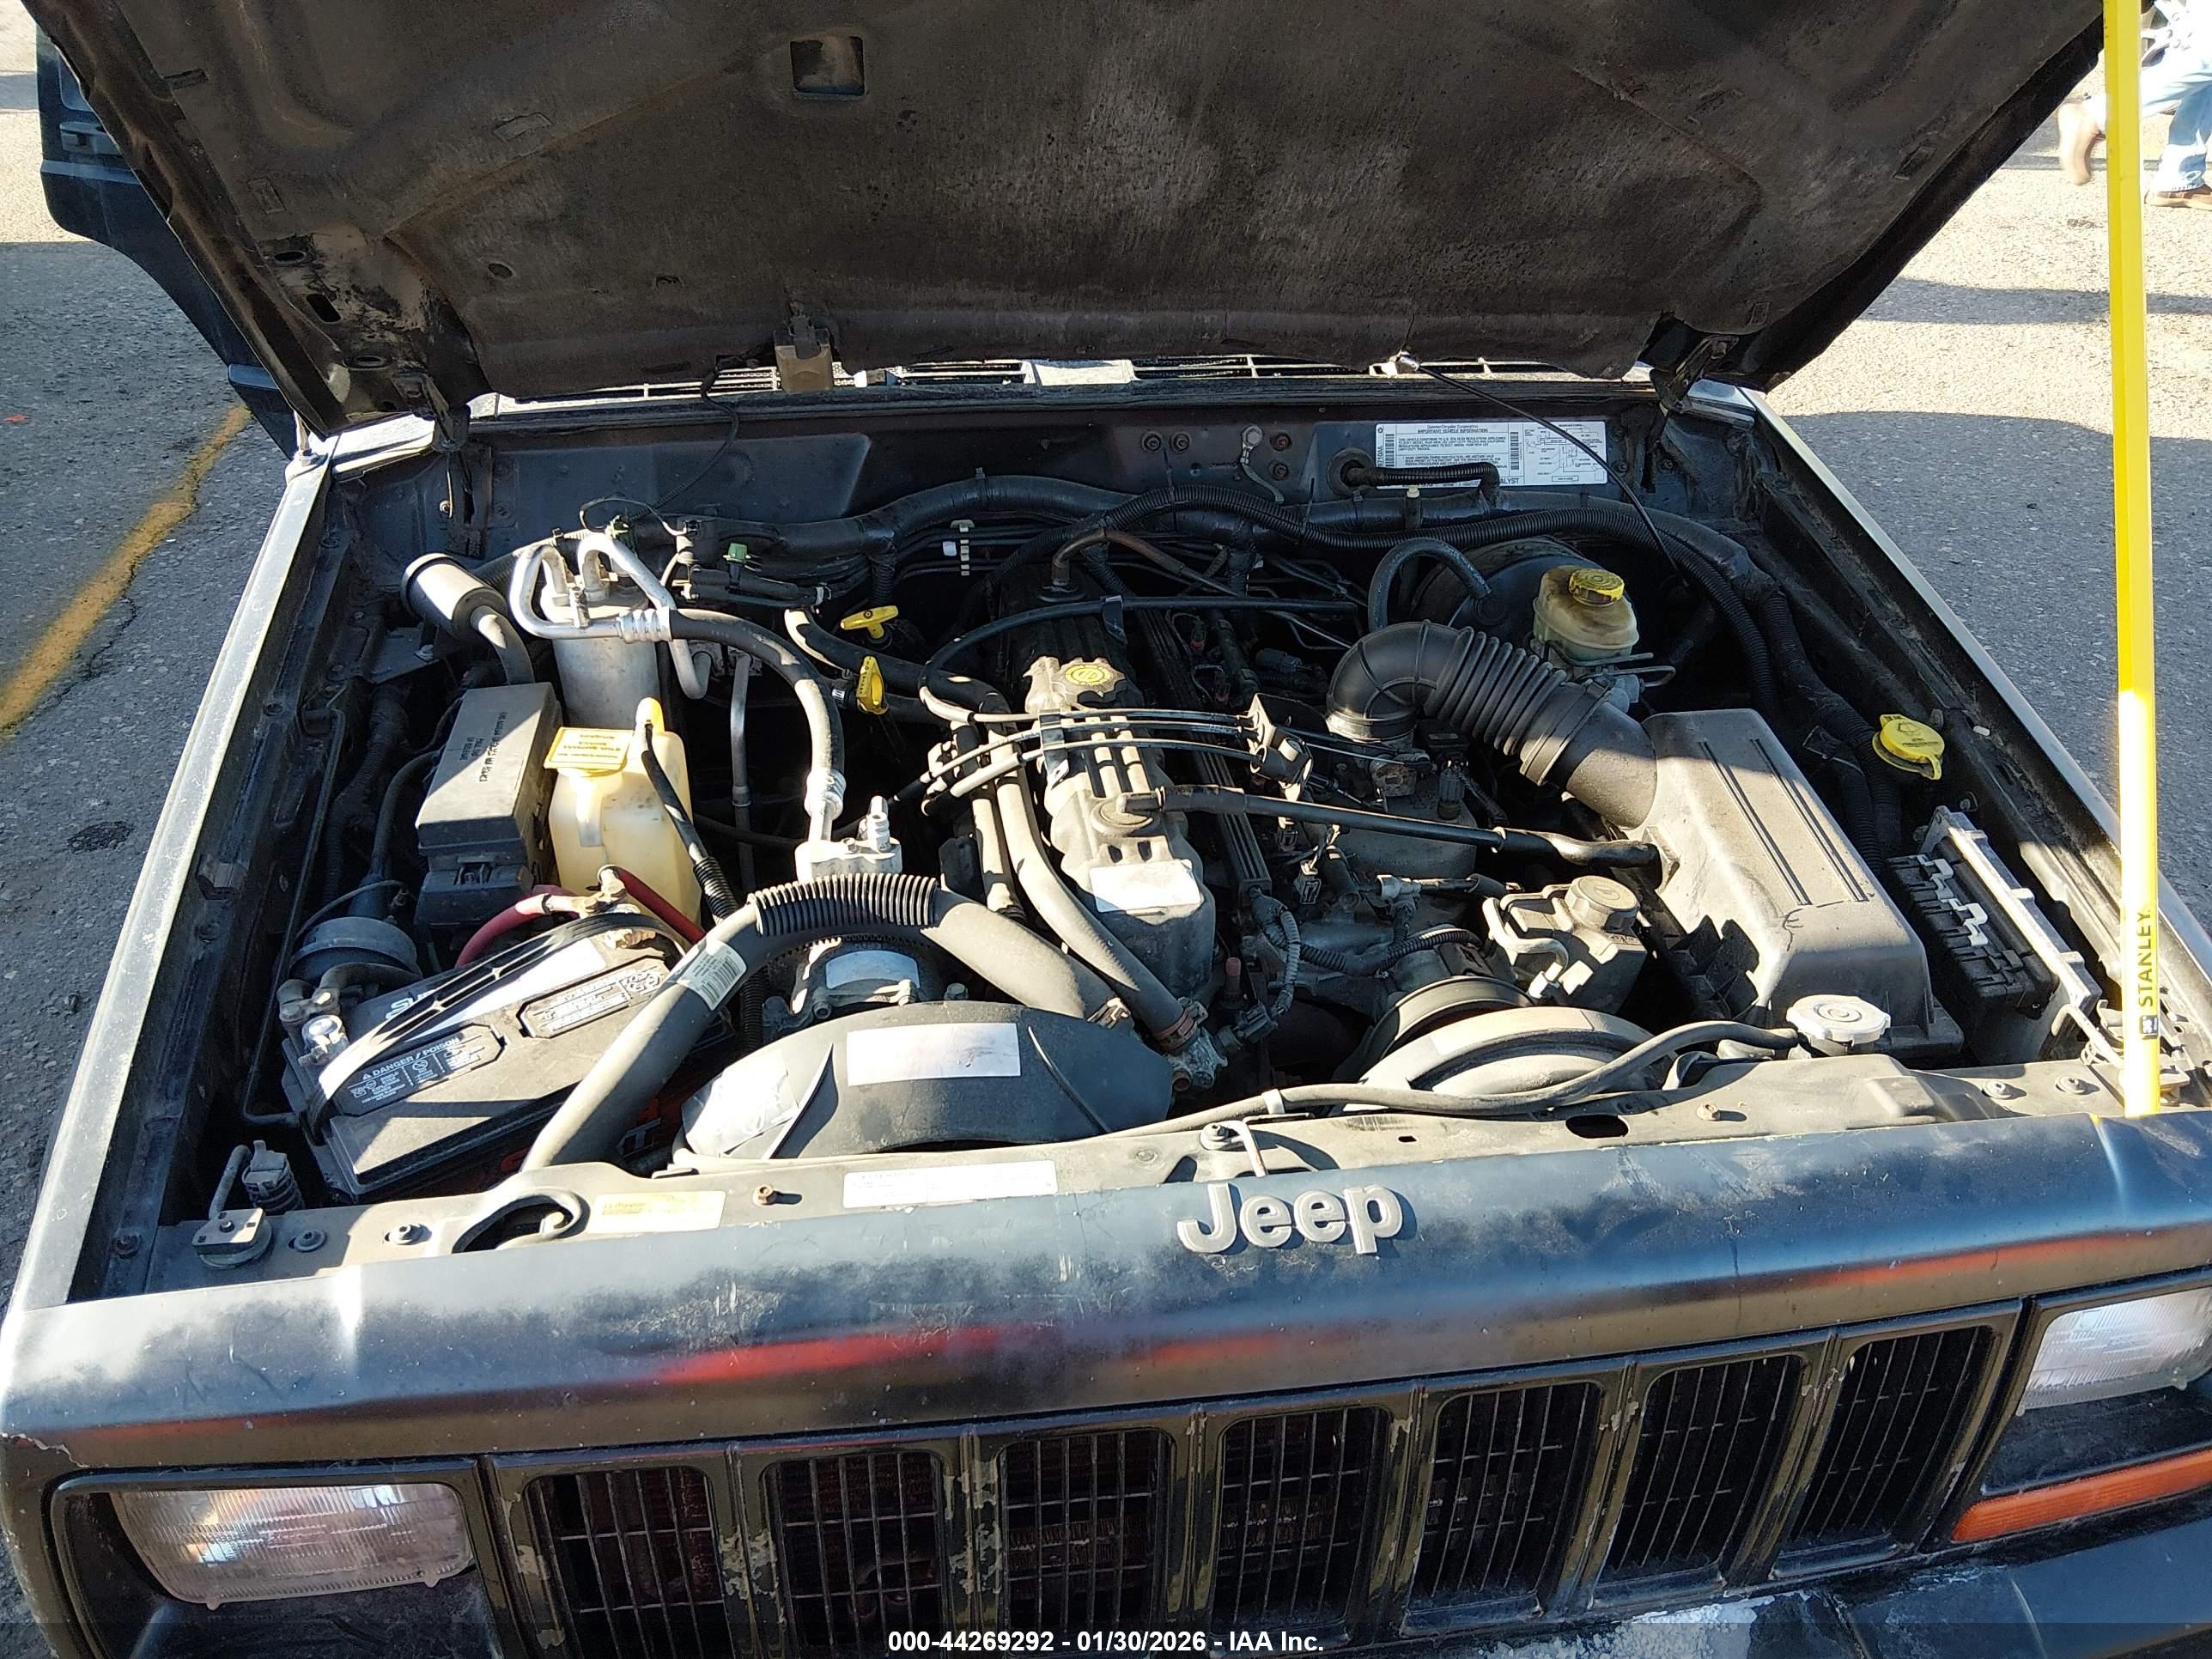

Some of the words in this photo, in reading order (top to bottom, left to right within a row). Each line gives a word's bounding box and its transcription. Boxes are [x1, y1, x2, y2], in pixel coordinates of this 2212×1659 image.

[373, 1055, 414, 1076] DANGER
[422, 1036, 461, 1056] POISON
[1177, 1182, 1403, 1255] Jeep
